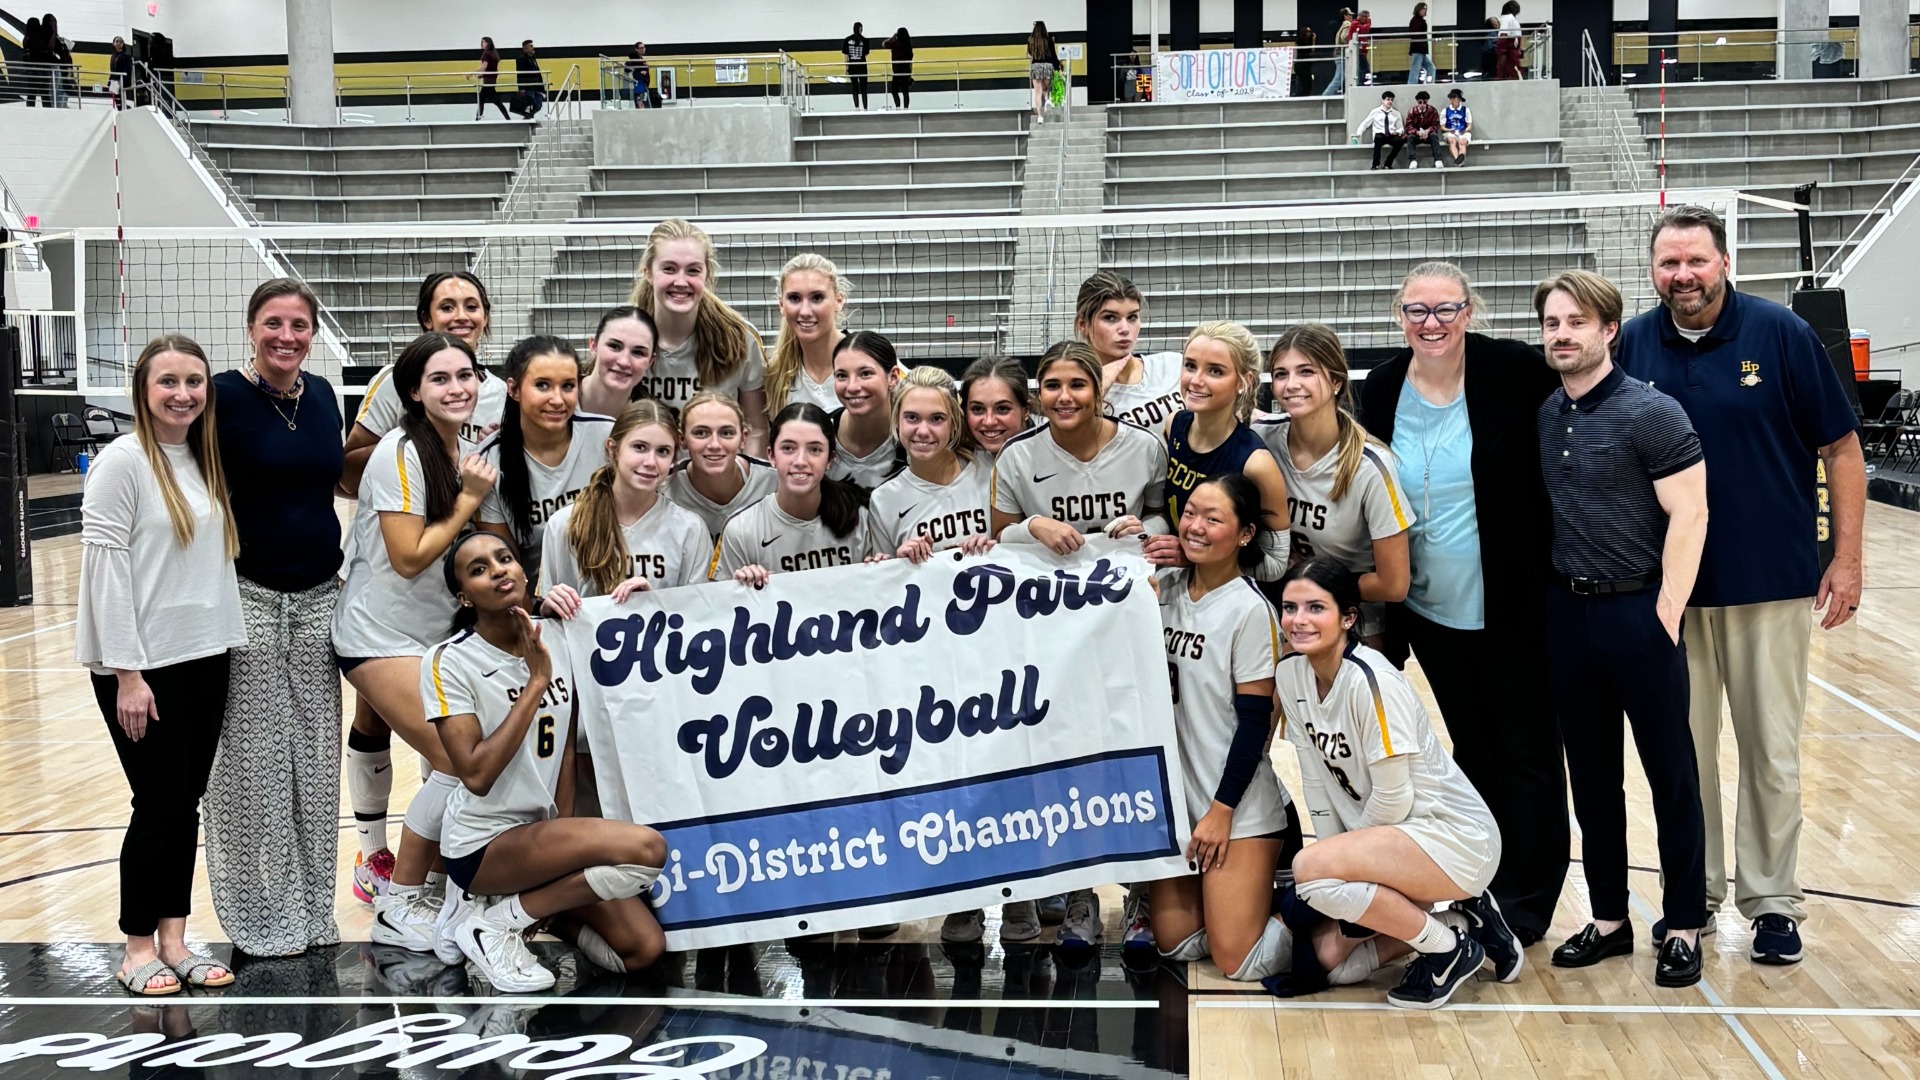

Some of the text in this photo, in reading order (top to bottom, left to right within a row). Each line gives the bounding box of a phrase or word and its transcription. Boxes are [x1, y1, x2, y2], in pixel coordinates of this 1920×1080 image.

[1169, 51, 1280, 91] SOPHOMORES
[1186, 88, 1210, 98] Class
[1166, 456, 1207, 491] SCO
[530, 487, 587, 526] SCOT
[1051, 490, 1128, 523] SCOTS
[1286, 496, 1328, 531] OTS
[916, 508, 988, 543] SCOTS
[625, 554, 666, 580] OTS
[780, 546, 851, 573] SCOTS
[590, 558, 1134, 696] Highland Park
[1163, 626, 1206, 660] COTS
[506, 676, 569, 709] STS
[536, 713, 556, 760] 6
[676, 664, 1051, 780] Volleyball
[898, 786, 1157, 866] Champions
